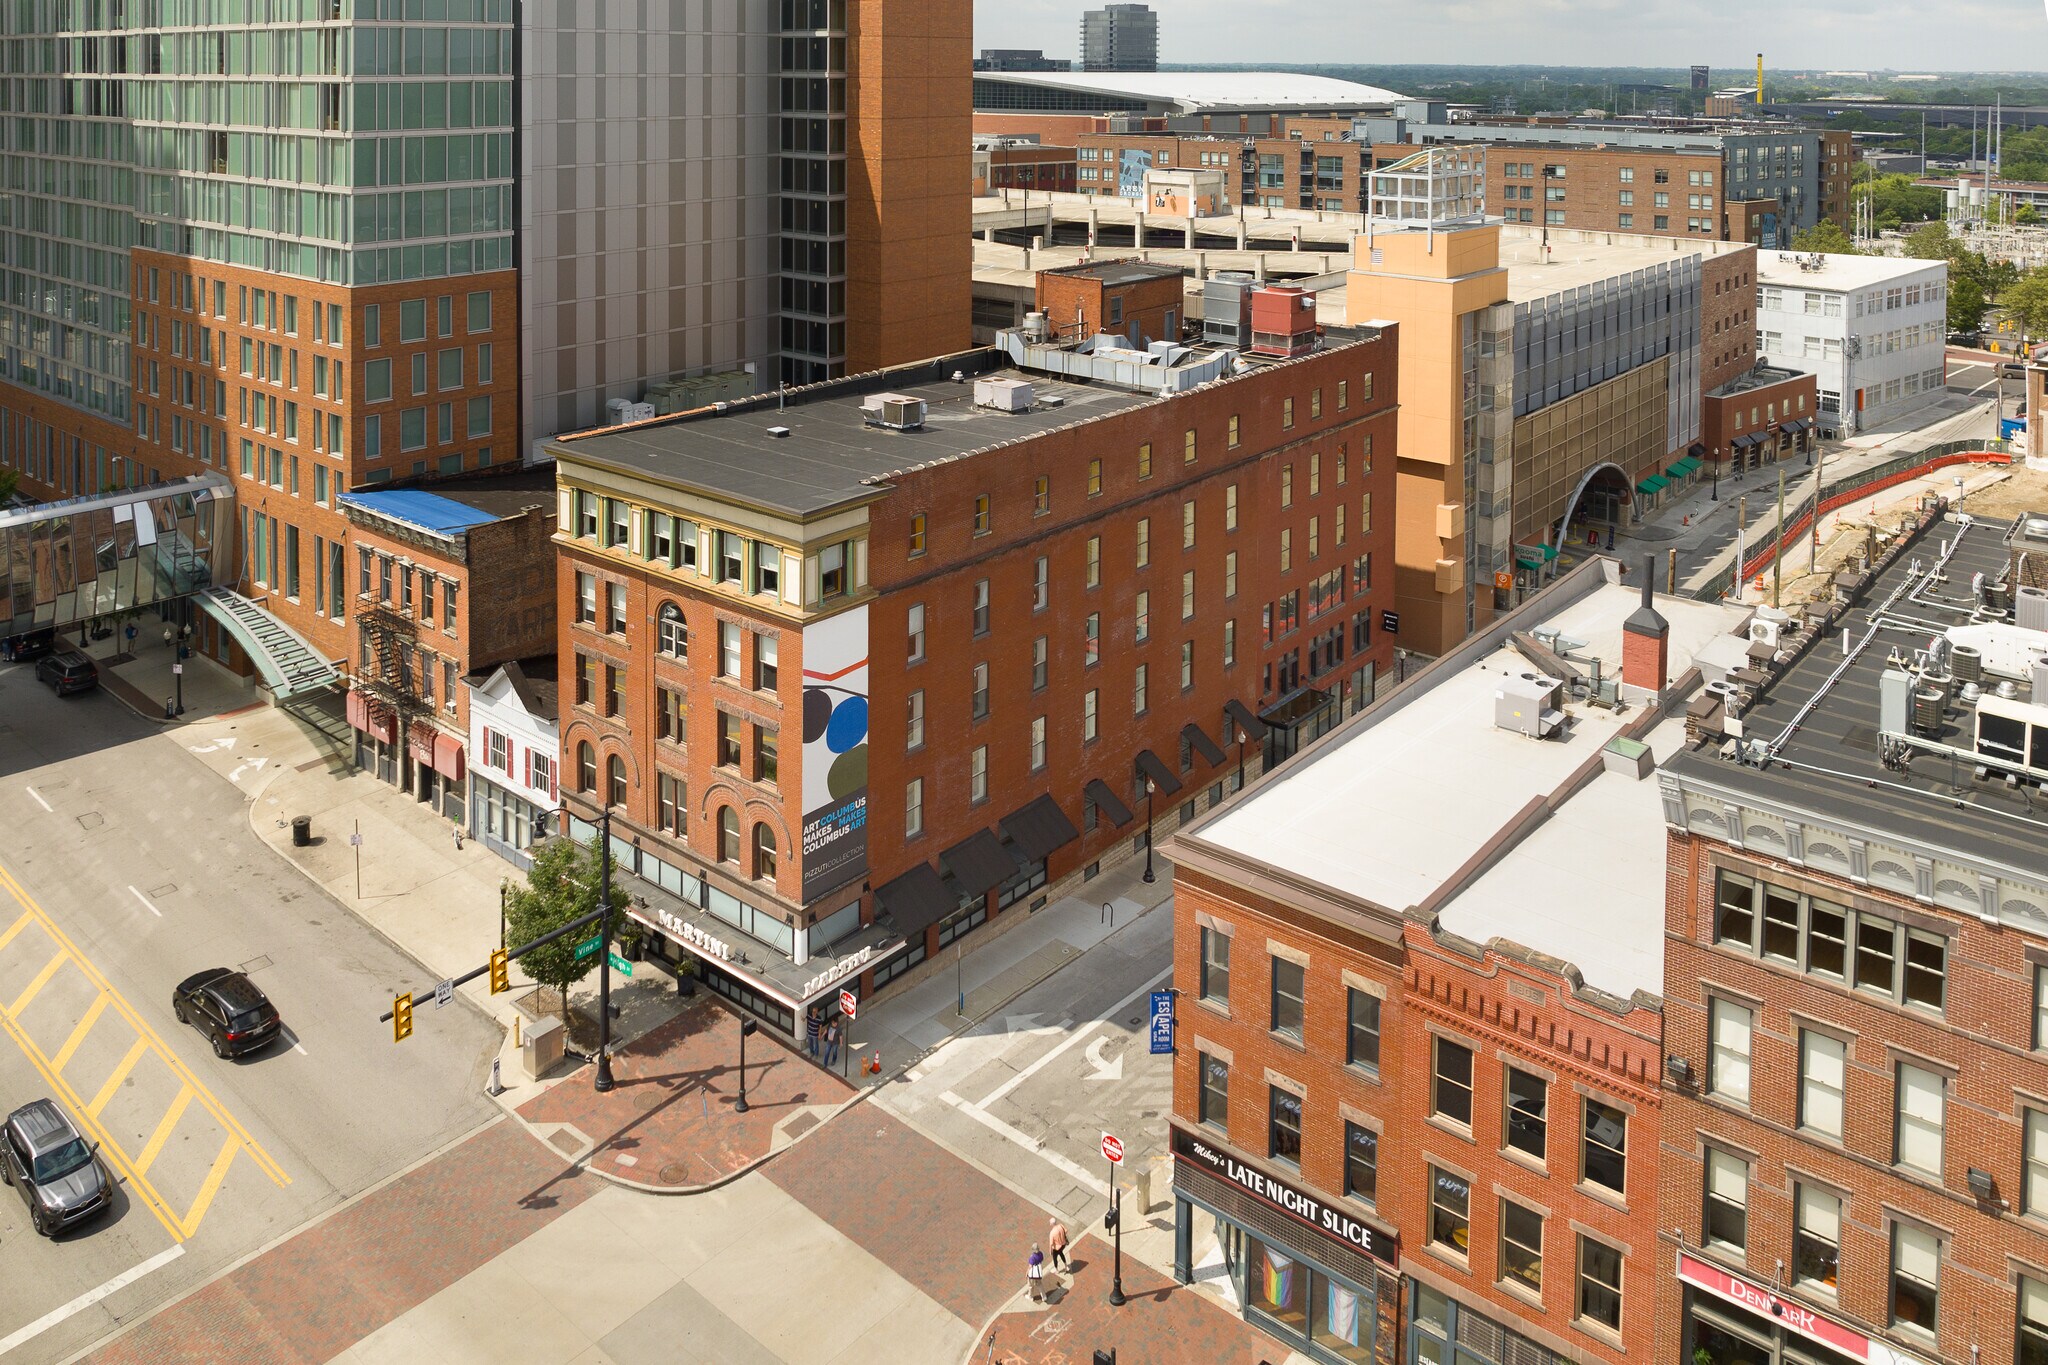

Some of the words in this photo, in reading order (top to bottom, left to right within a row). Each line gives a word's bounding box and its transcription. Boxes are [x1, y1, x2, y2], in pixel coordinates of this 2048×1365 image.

[803, 820, 820, 836] ART
[820, 796, 867, 826] COLUMBUS
[803, 824, 832, 846] MAKES
[838, 806, 867, 827] MAKES
[803, 825, 850, 855] COLUMBUS
[850, 816, 867, 831] ART
[578, 944, 593, 956] Vine
[658, 909, 730, 961] MARTINI
[437, 980, 450, 992] ONE
[802, 945, 872, 999] MARTINI
[438, 987, 451, 998] WAY
[1193, 1143, 1225, 1166] Mikey's
[1227, 1159, 1264, 1194] LATE
[1266, 1179, 1319, 1221] NIGHT
[1322, 1208, 1372, 1250] SLICE
[1437, 1177, 1468, 1198] OUT?
